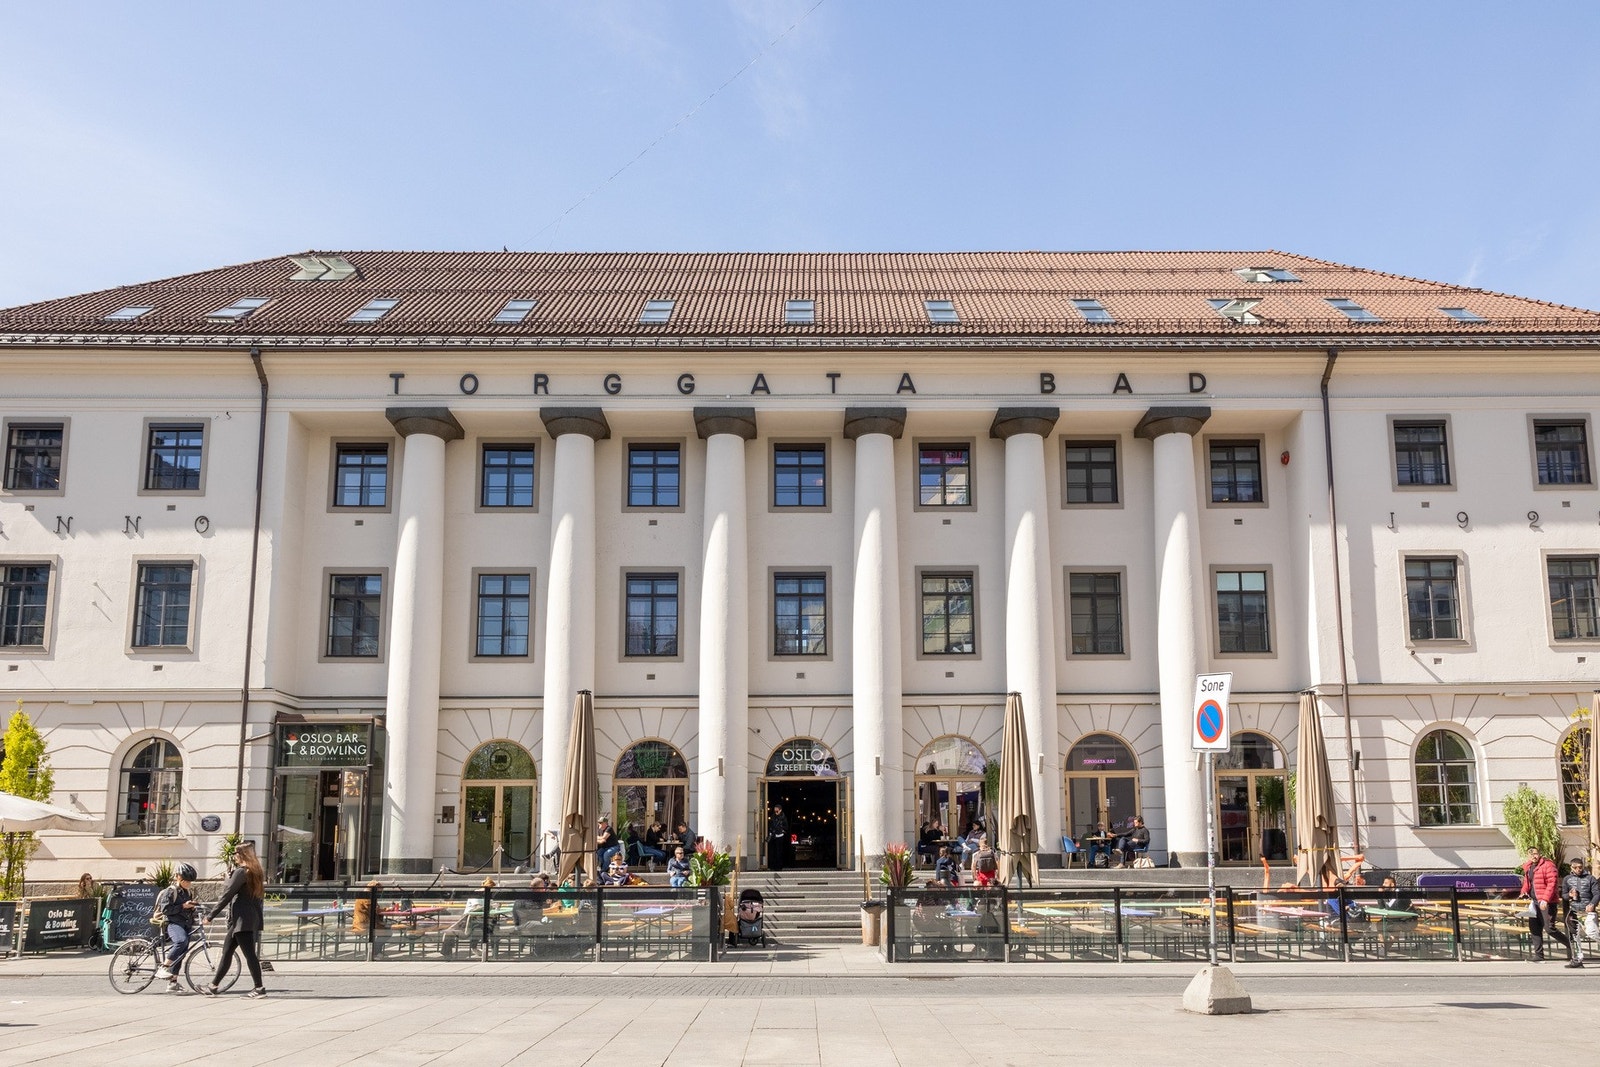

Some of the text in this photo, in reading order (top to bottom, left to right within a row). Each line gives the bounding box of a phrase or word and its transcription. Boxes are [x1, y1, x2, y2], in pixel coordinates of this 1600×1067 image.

[390, 373, 1207, 395] TORGGATA BAD
[0, 515, 210, 534] NNO
[1387, 511, 1600, 529] 192
[1201, 679, 1224, 692] Sone
[300, 733, 358, 744] OSLO BAR
[299, 745, 367, 756] & BOWLING
[782, 748, 824, 761] OSLO
[774, 764, 830, 772] STREET FOOD
[48, 909, 74, 919] Oslo Bar
[45, 919, 77, 929] & Bowling
